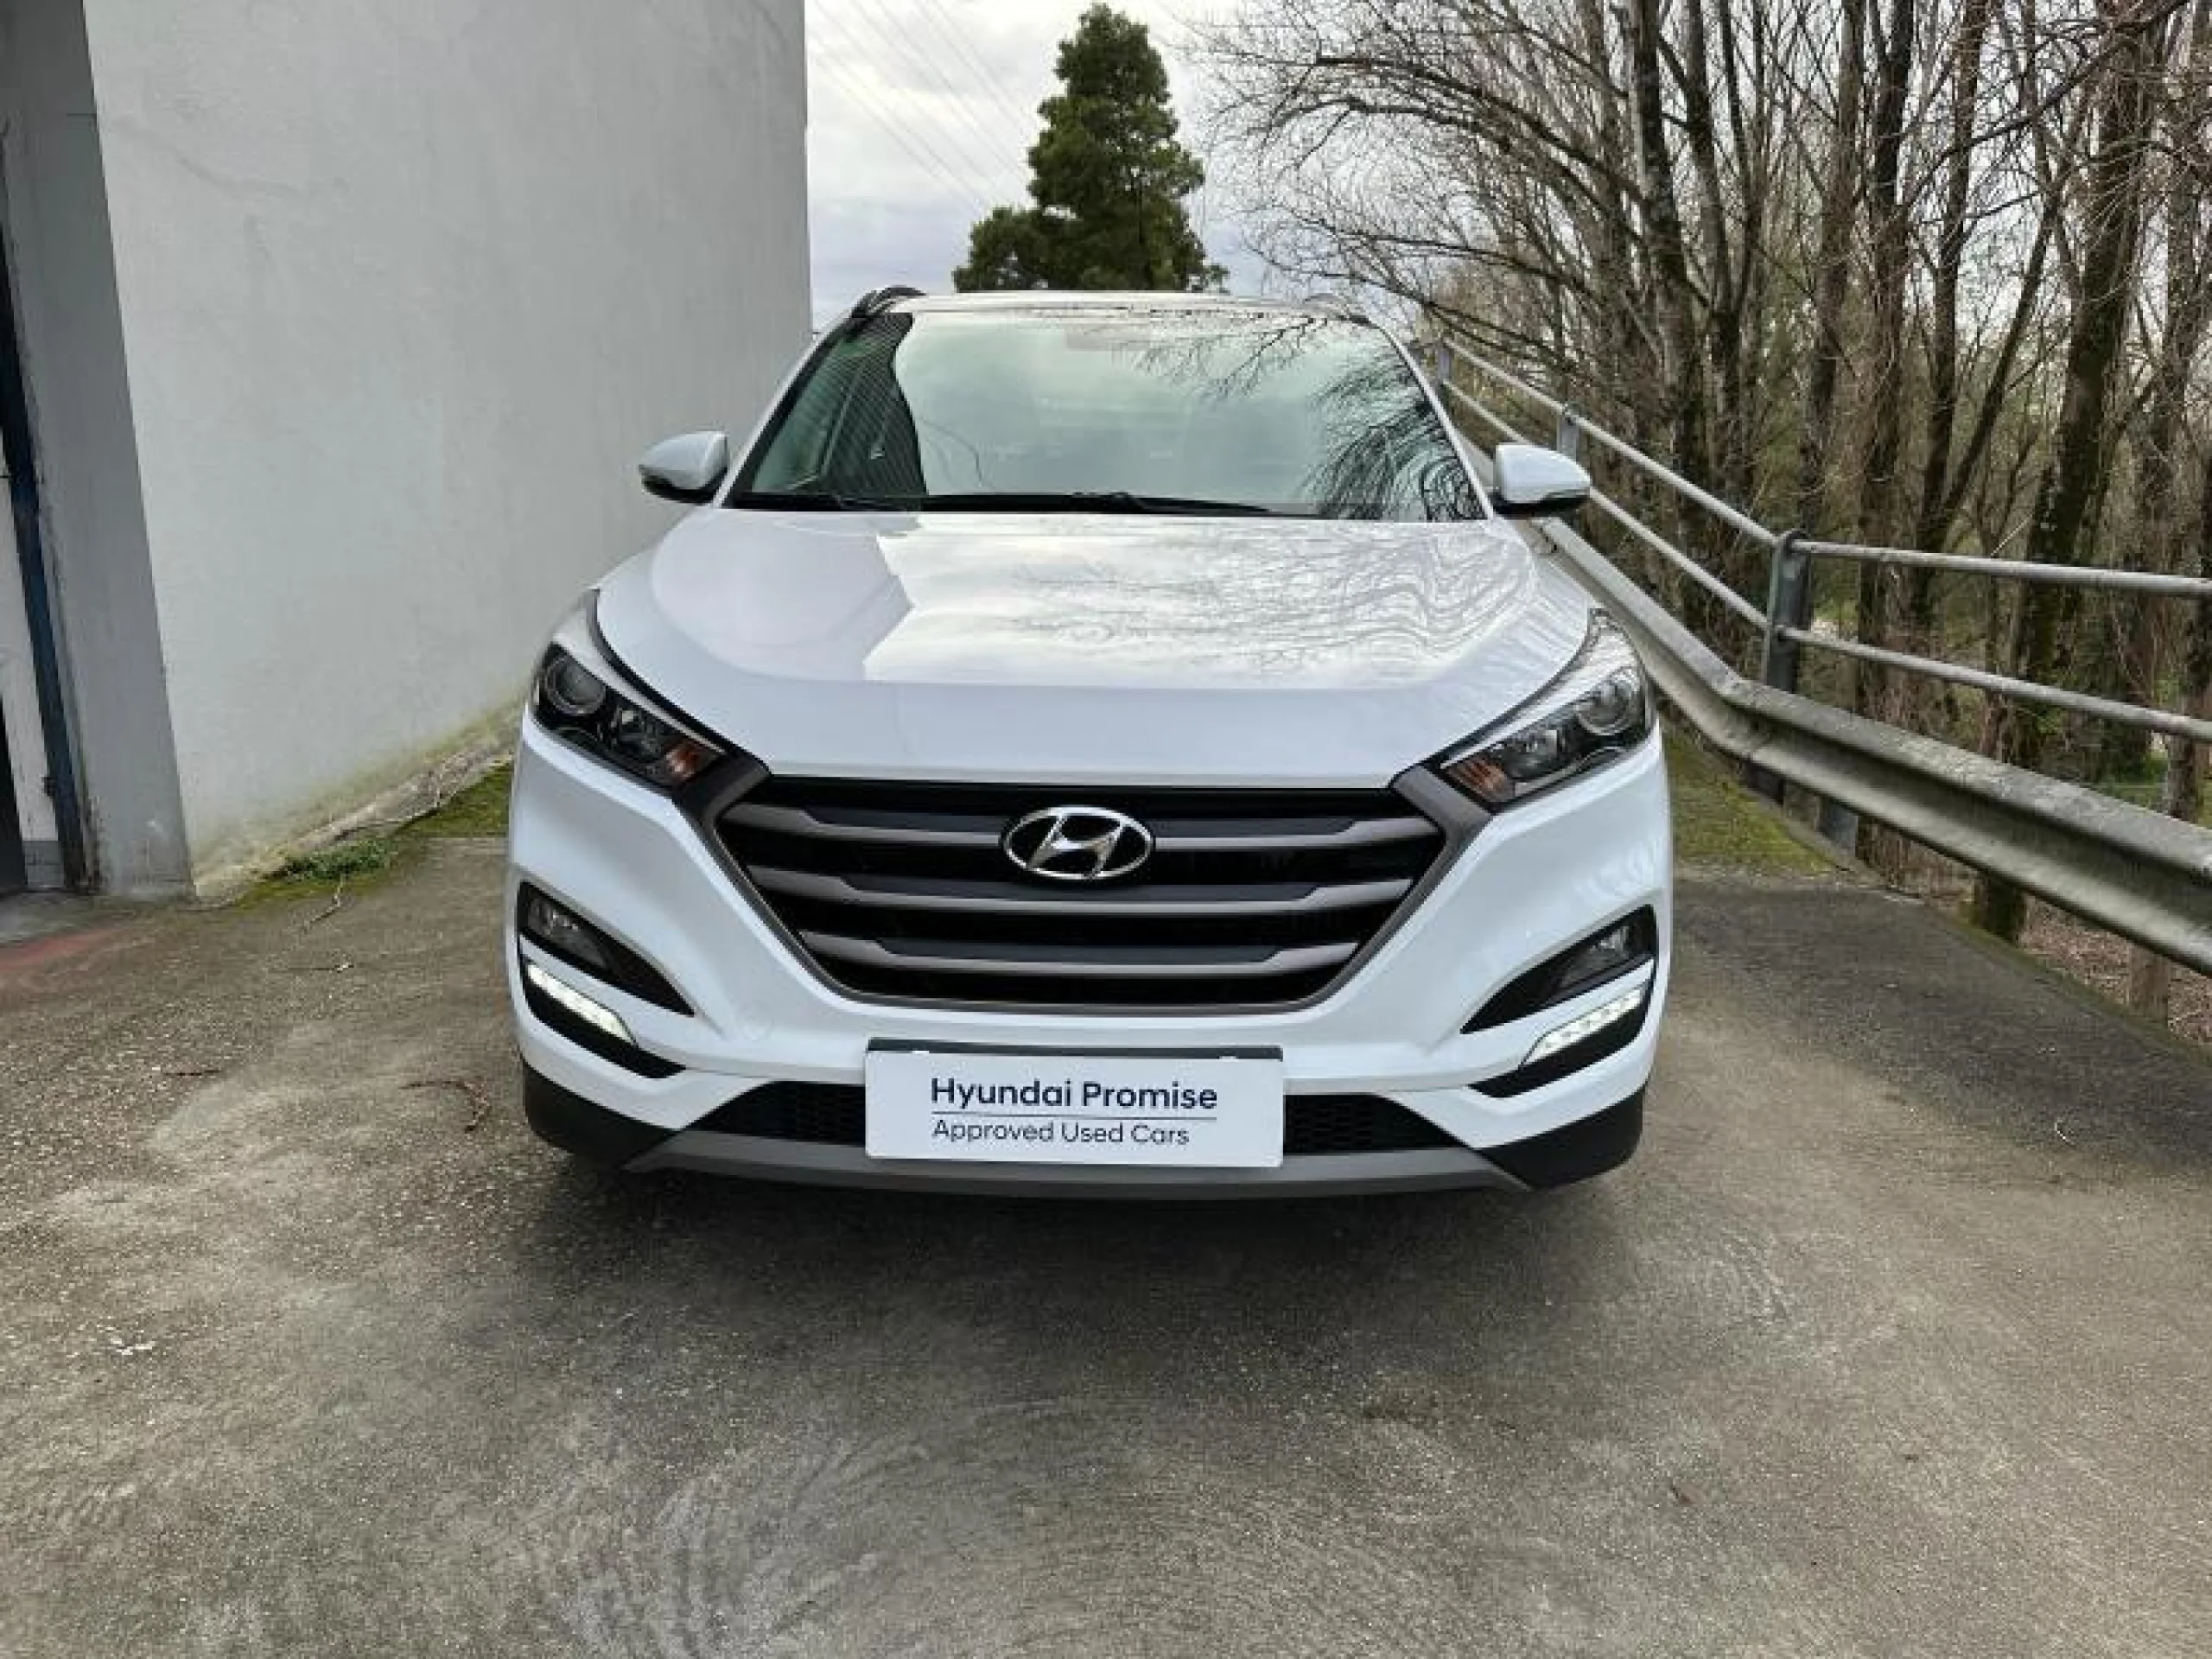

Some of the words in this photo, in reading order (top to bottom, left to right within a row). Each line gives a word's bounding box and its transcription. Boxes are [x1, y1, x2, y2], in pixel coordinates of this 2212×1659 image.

[931, 1077, 1071, 1109] Hyundai
[1082, 1080, 1217, 1109] Promise
[932, 1119, 1054, 1143] Approved
[1061, 1120, 1123, 1143] Used
[1130, 1123, 1191, 1146] Cars
